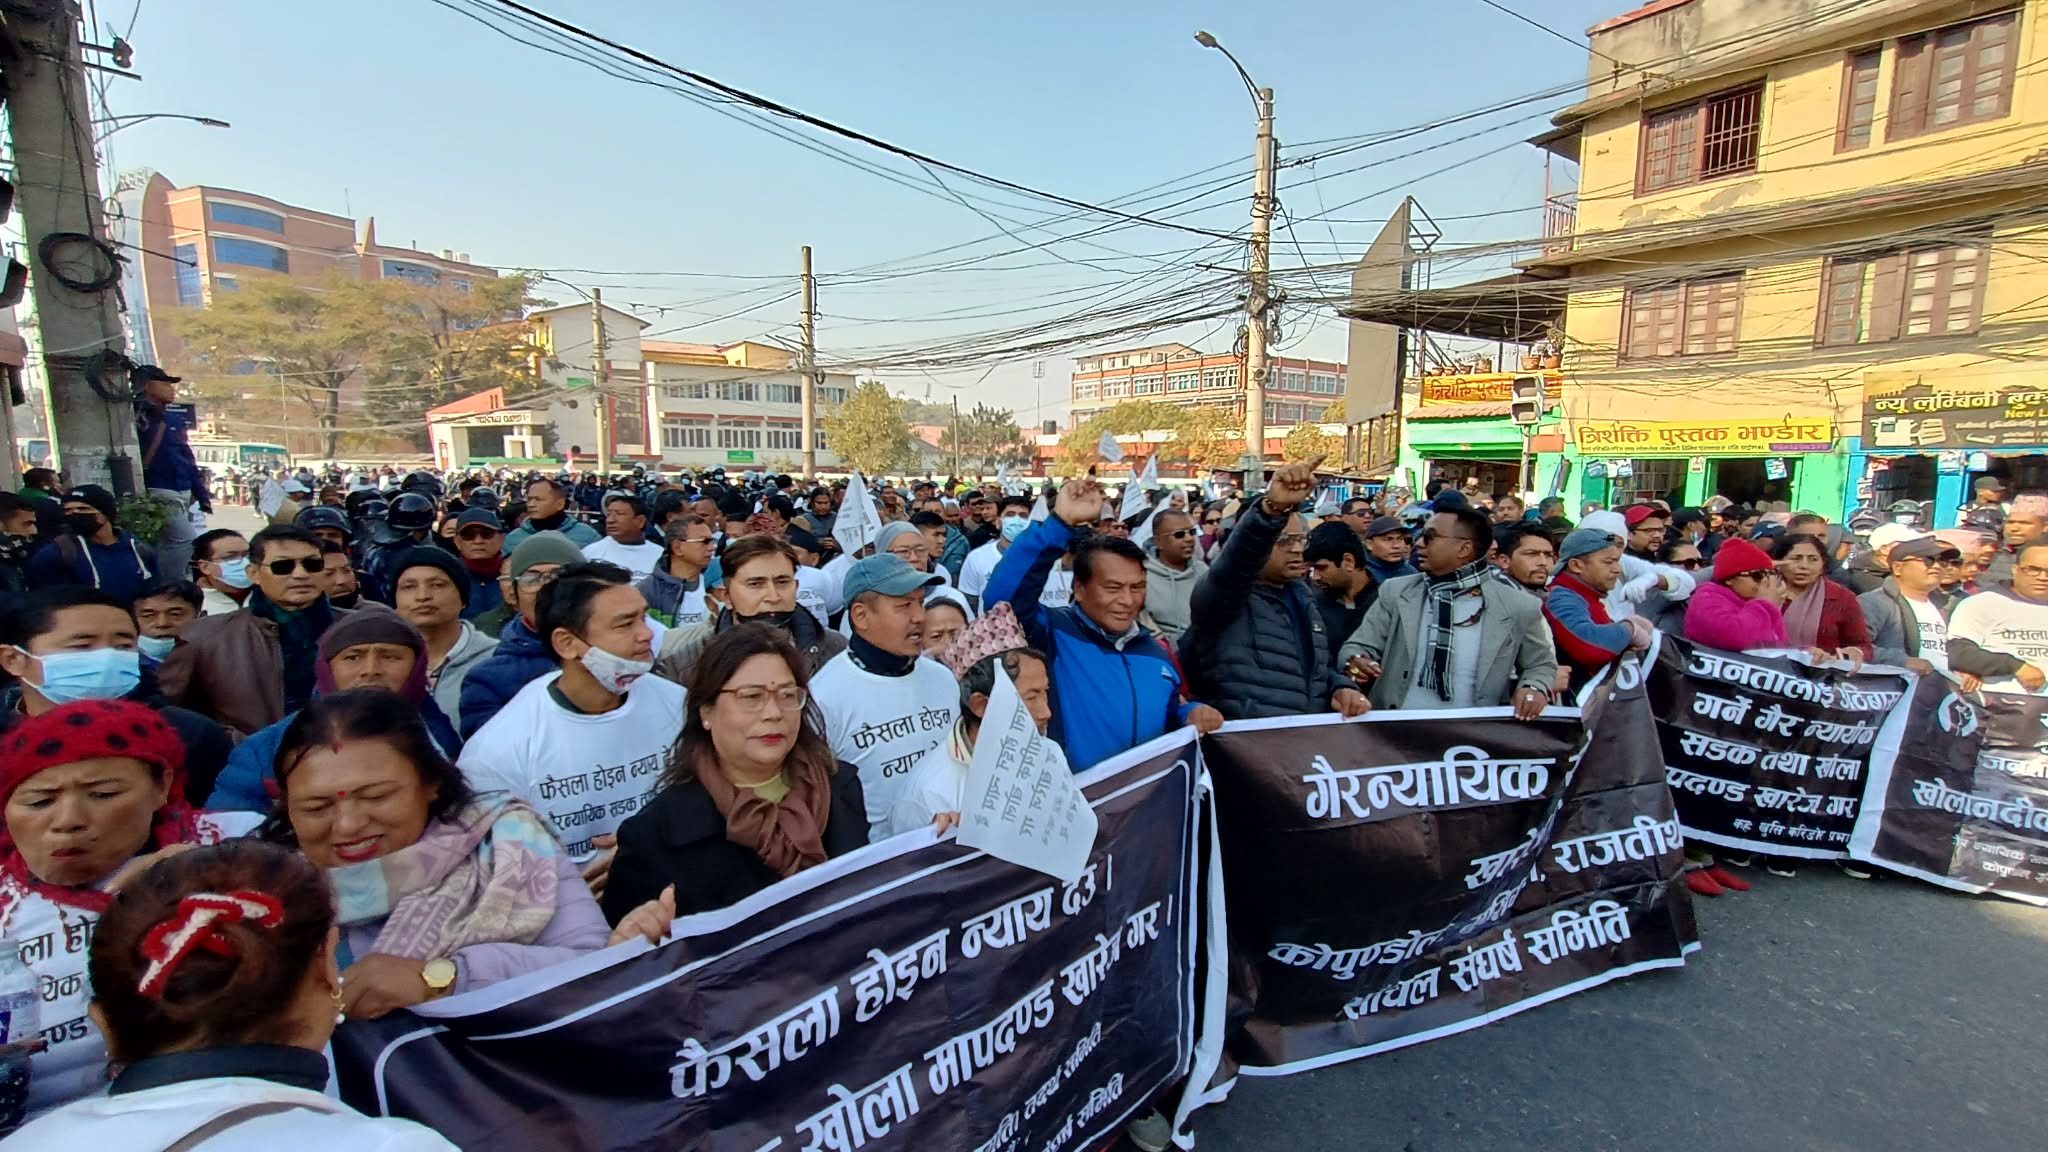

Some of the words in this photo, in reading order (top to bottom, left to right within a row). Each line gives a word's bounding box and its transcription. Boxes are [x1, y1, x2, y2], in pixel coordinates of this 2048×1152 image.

[1875, 398, 1909, 414] न्यू
[1913, 392, 2002, 413] लुम्बिनी
[2004, 410, 2035, 418] New
[1579, 425, 1650, 445] त्रिशक्ति
[1659, 427, 1729, 446] पुस्तक
[1737, 424, 1826, 441] भण्डार
[851, 714, 916, 750] फैसला
[919, 706, 952, 732] होइन
[1693, 691, 1753, 725] गर्ने
[1755, 704, 1804, 736] गैर
[1680, 730, 1762, 765] सडक
[1761, 750, 1810, 776] तथा
[540, 773, 589, 800] फैसला
[592, 763, 627, 792] होइन
[630, 753, 661, 778] न्याय
[1303, 746, 1556, 819] गैरन्यायिक
[1665, 765, 1751, 802] पदण्ड
[1754, 786, 1823, 814] खारेज
[1826, 795, 1858, 818] गर
[609, 796, 637, 818] सडक
[1828, 830, 1851, 843] प्रभा
[1449, 928, 1523, 992] संघर्ष
[1524, 900, 1632, 965] समिति
[669, 985, 840, 1099] फैसला
[850, 929, 951, 1023] होइन
[961, 888, 1054, 961] न्याय
[923, 978, 1057, 1097] मापदण्ड
[1059, 925, 1124, 1005] खारेज
[1126, 901, 1161, 949] गर
[1077, 1072, 1125, 1128] समिति
